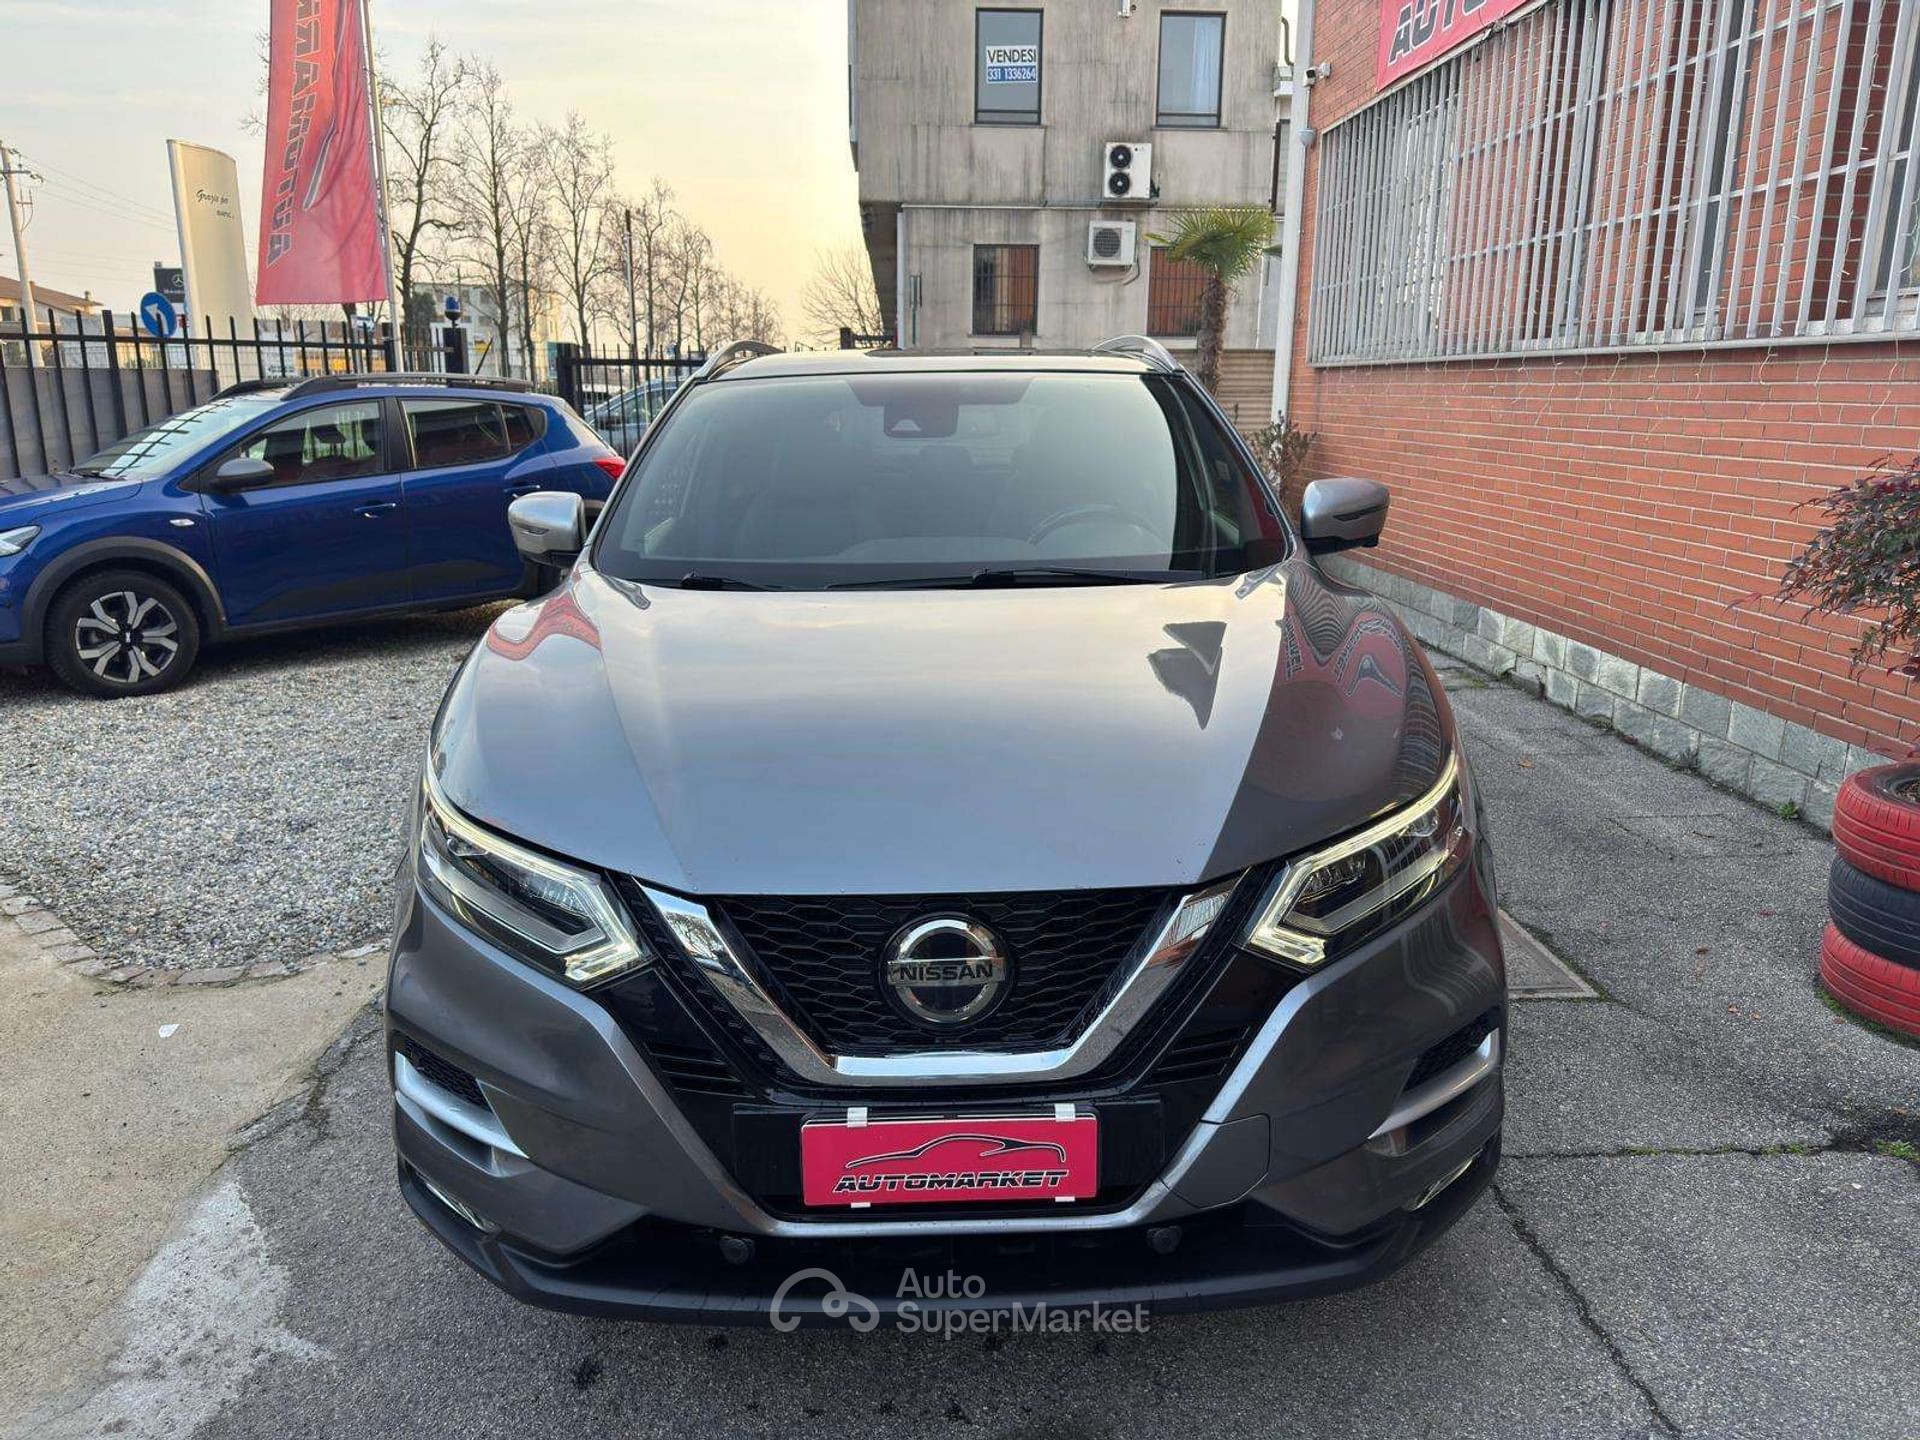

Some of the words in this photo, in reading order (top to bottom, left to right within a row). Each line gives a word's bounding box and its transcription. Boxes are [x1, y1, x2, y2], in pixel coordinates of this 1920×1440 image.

[987, 48, 1037, 64] VENDESI
[987, 67, 1001, 81] 331
[900, 963, 993, 981] NISSAN
[832, 1170, 1069, 1193] AUTOMARKET
